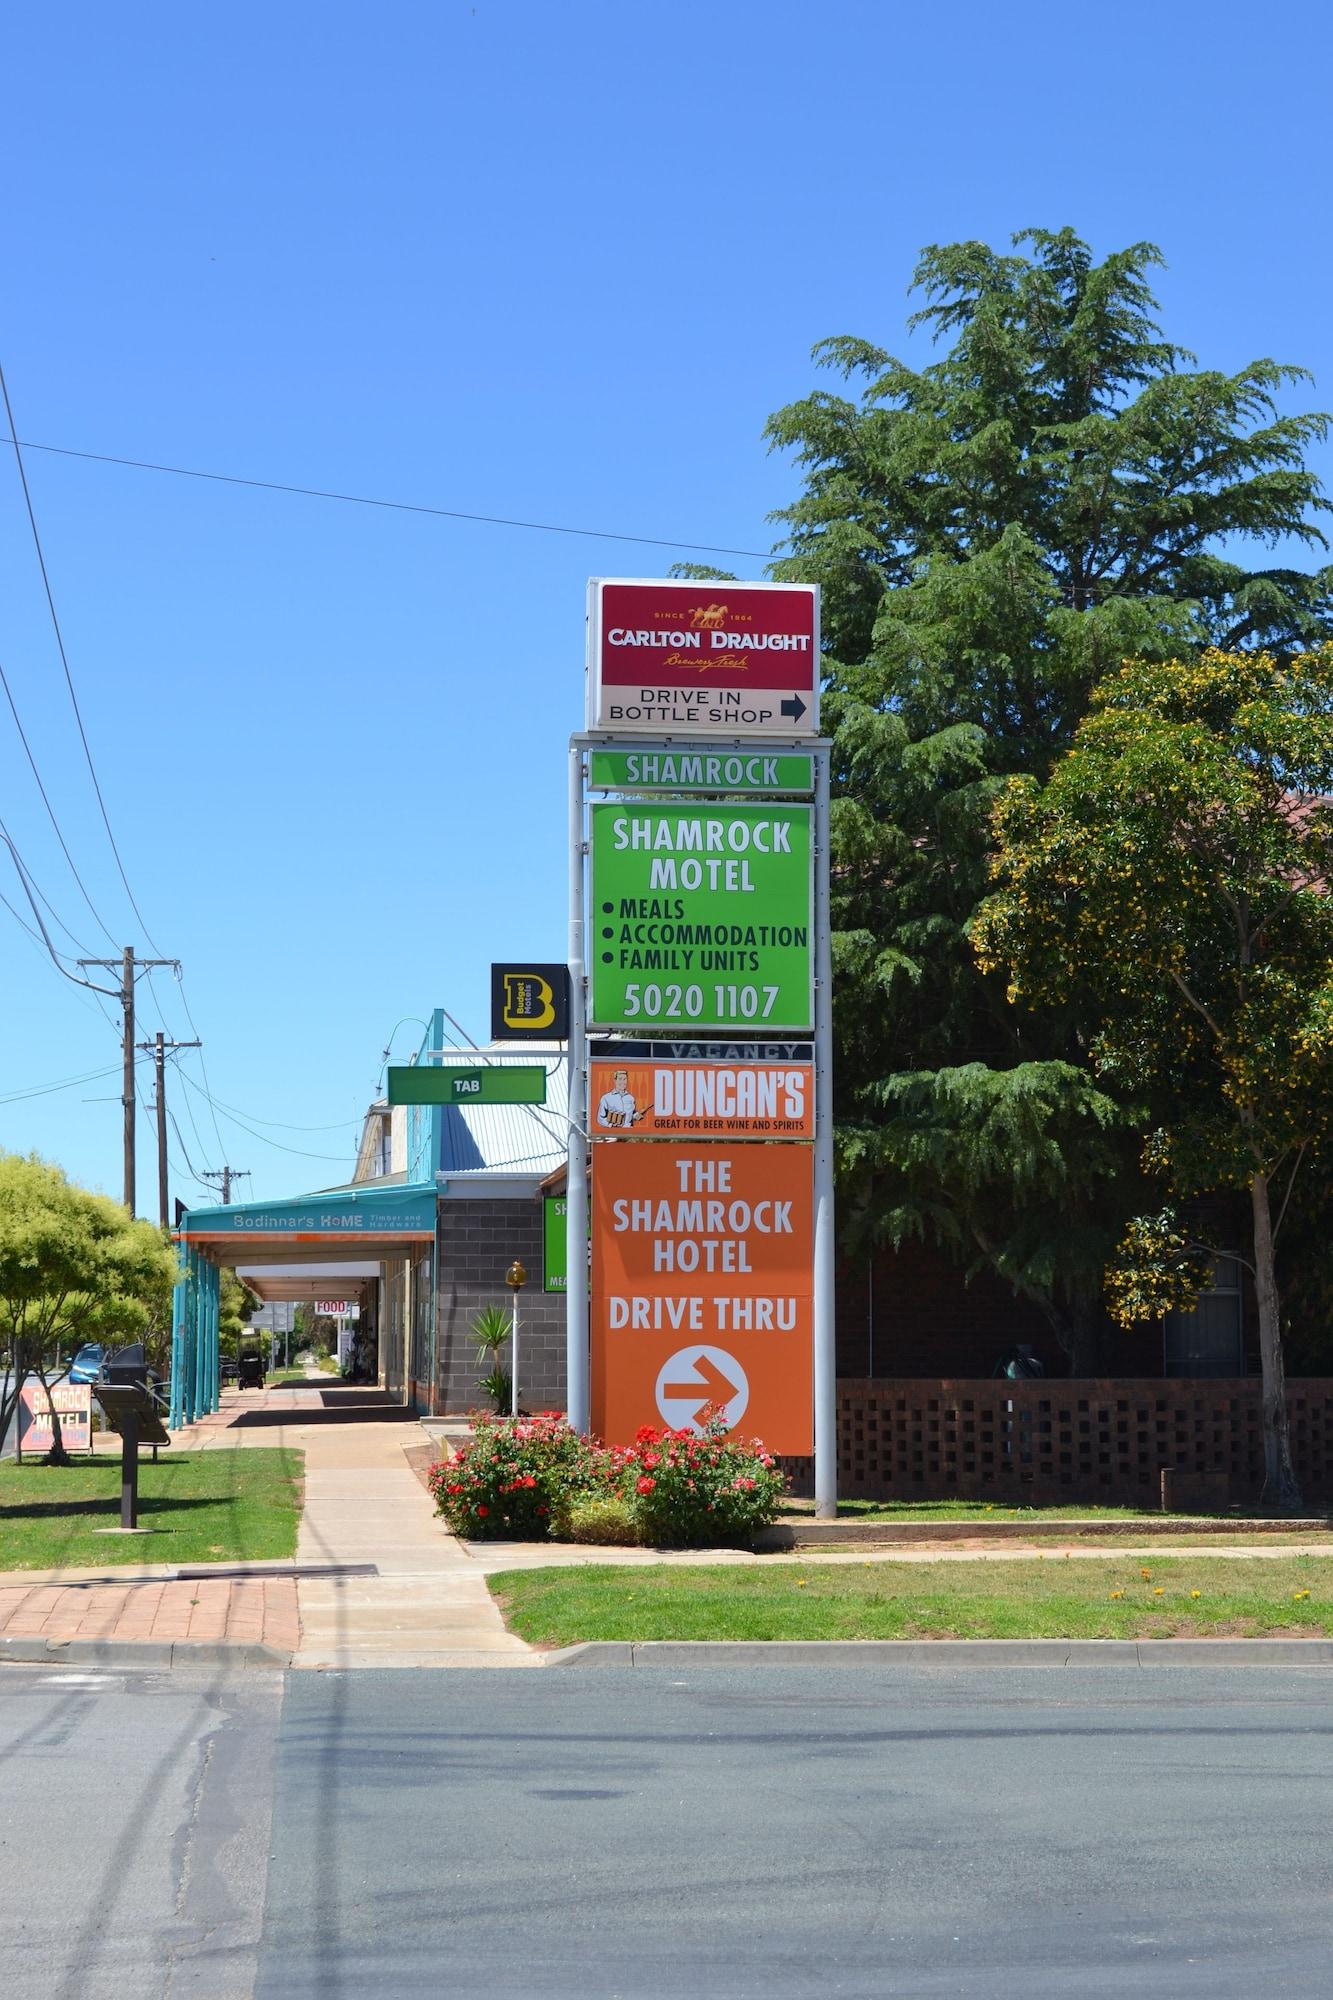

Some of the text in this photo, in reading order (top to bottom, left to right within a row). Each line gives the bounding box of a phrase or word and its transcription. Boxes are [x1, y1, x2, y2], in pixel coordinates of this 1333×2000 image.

[607, 628, 810, 651] CARLTON DRAUGHT
[640, 689, 741, 705] DRIVE IN
[610, 706, 772, 723] BOTTLE SHOP
[626, 755, 779, 785] SHAMROCK
[613, 818, 792, 853] SHAMROCK
[649, 858, 755, 892] MOTEL
[619, 899, 684, 920] MEALS
[619, 924, 807, 947] ACCOMMODATION
[619, 949, 759, 971] FAMILY UNITS
[516, 982, 526, 1014] Budget
[623, 984, 780, 1018] 5020 1107
[670, 1043, 799, 1060] VACANCY
[453, 1080, 480, 1092] TAB
[654, 1069, 804, 1119] DUNCAN'S
[654, 1119, 804, 1131] GREAT FOR BEER WINE AND SPIRITS
[675, 1160, 732, 1193] THE
[233, 1215, 315, 1228] Bodinnar's
[613, 1199, 793, 1233] SHAMROCK
[654, 1239, 752, 1273] HOTEL
[317, 1300, 345, 1312] FOOD
[610, 1296, 796, 1331] DRIVE THRU
[33, 1386, 89, 1414] SHMROCK
